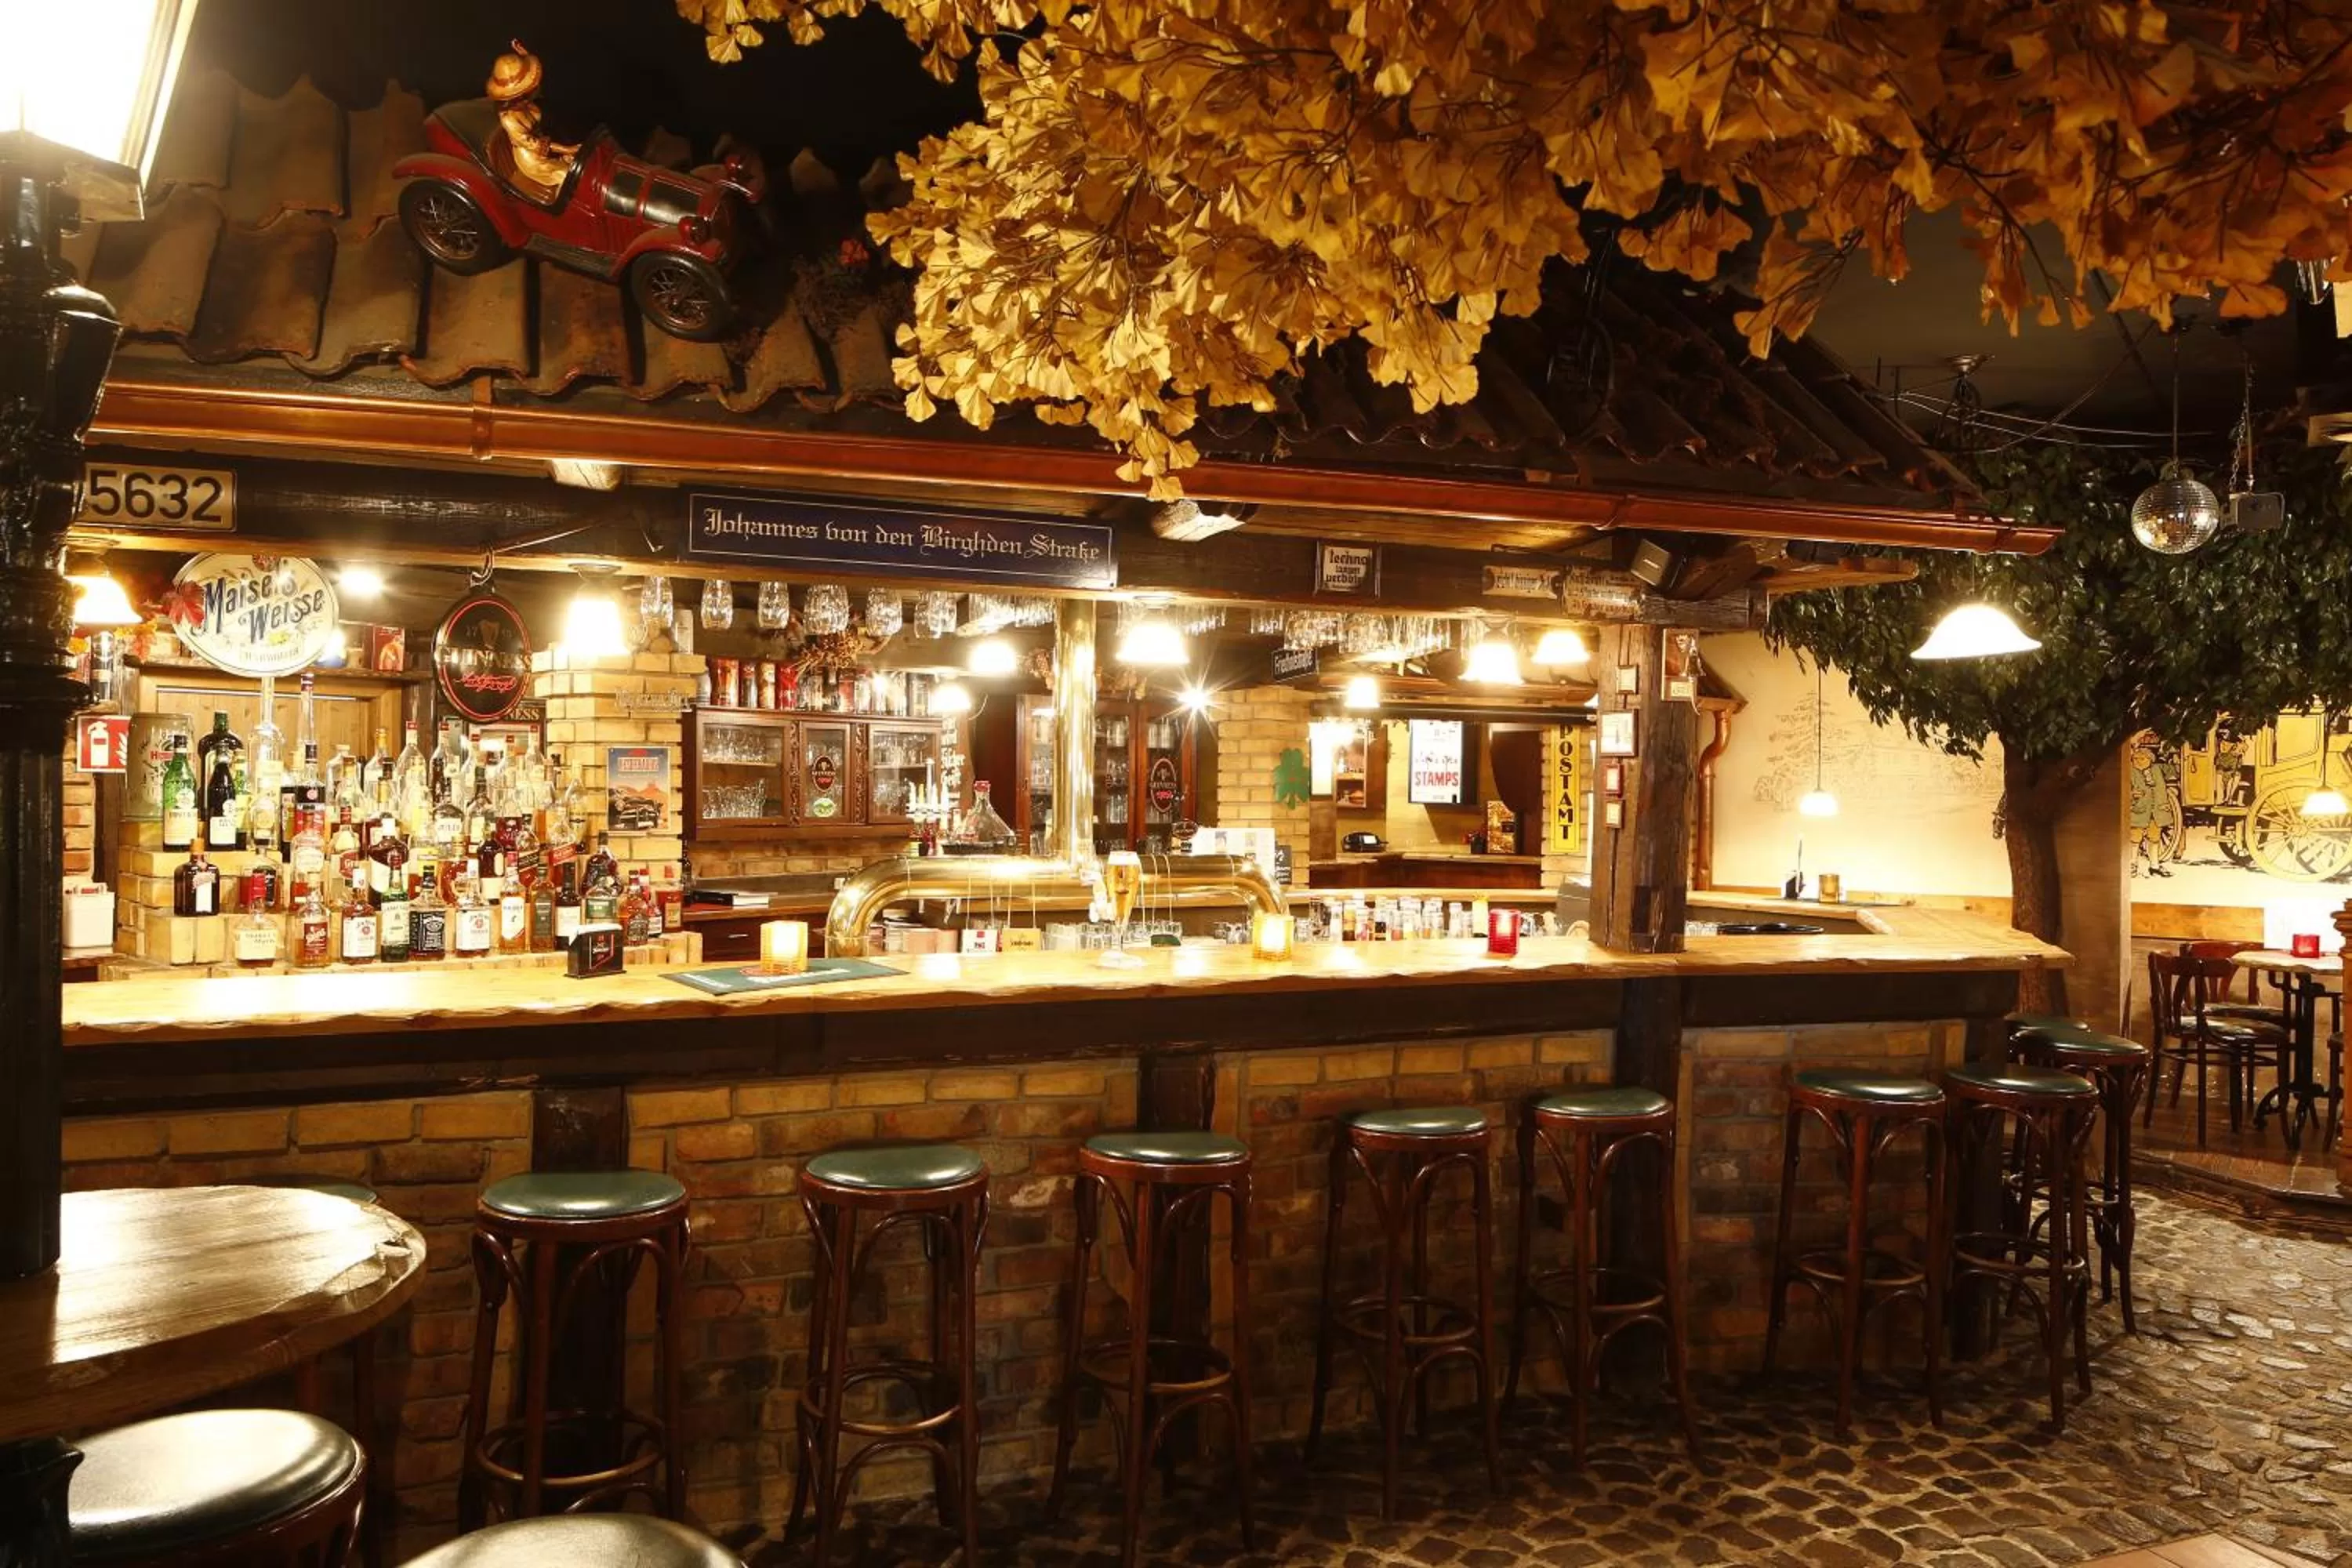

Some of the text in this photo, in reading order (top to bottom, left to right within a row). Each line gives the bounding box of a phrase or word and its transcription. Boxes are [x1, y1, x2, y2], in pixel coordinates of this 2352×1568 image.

[89, 470, 222, 523] 5632
[704, 507, 819, 540] Johannes
[826, 521, 867, 544] von
[874, 524, 913, 546] den
[920, 524, 1022, 558] Birghden
[1326, 573, 1365, 583] verbot
[238, 589, 326, 644] Weisse
[1414, 771, 1459, 786] STAMPS
[1558, 724, 1573, 840] POSTAMT
